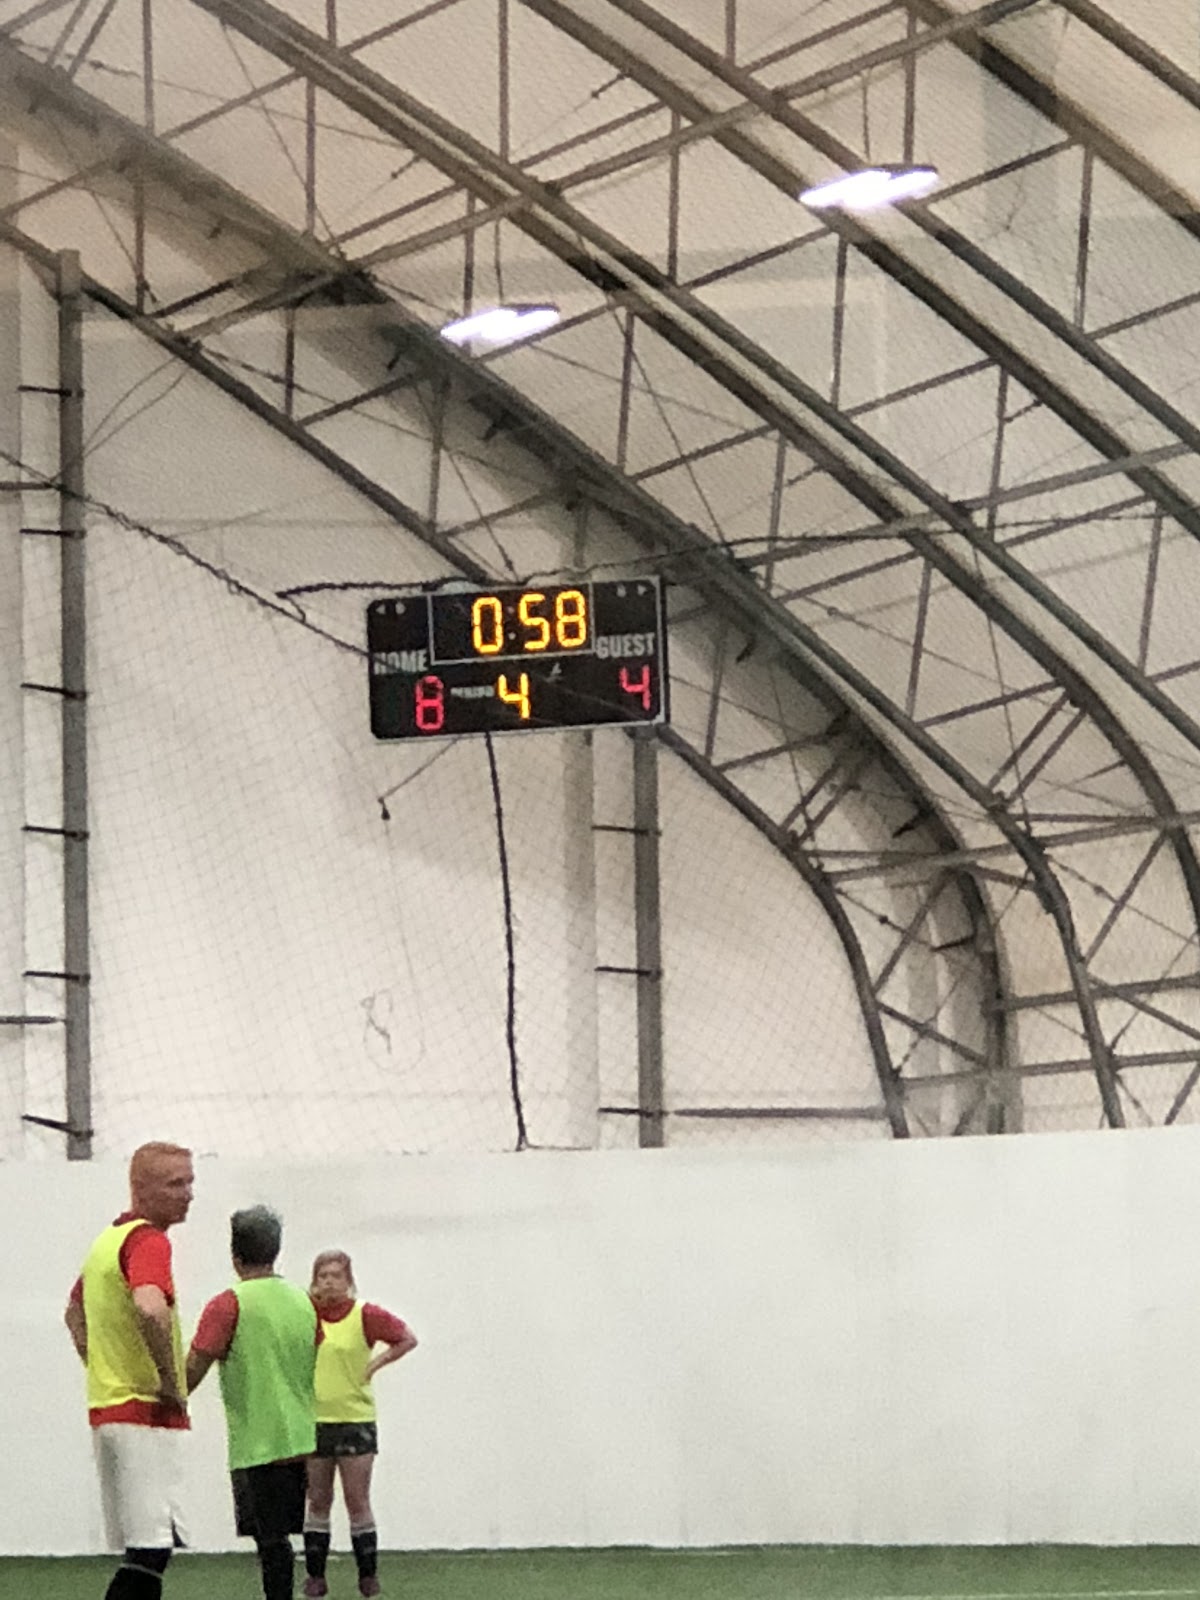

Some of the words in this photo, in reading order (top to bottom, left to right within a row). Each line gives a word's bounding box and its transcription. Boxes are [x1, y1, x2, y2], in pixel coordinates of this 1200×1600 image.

[472, 590, 587, 653] 0:58
[596, 632, 655, 659] GUEST
[415, 675, 444, 730] 8
[498, 672, 531, 719] 4
[619, 664, 651, 711] 4
